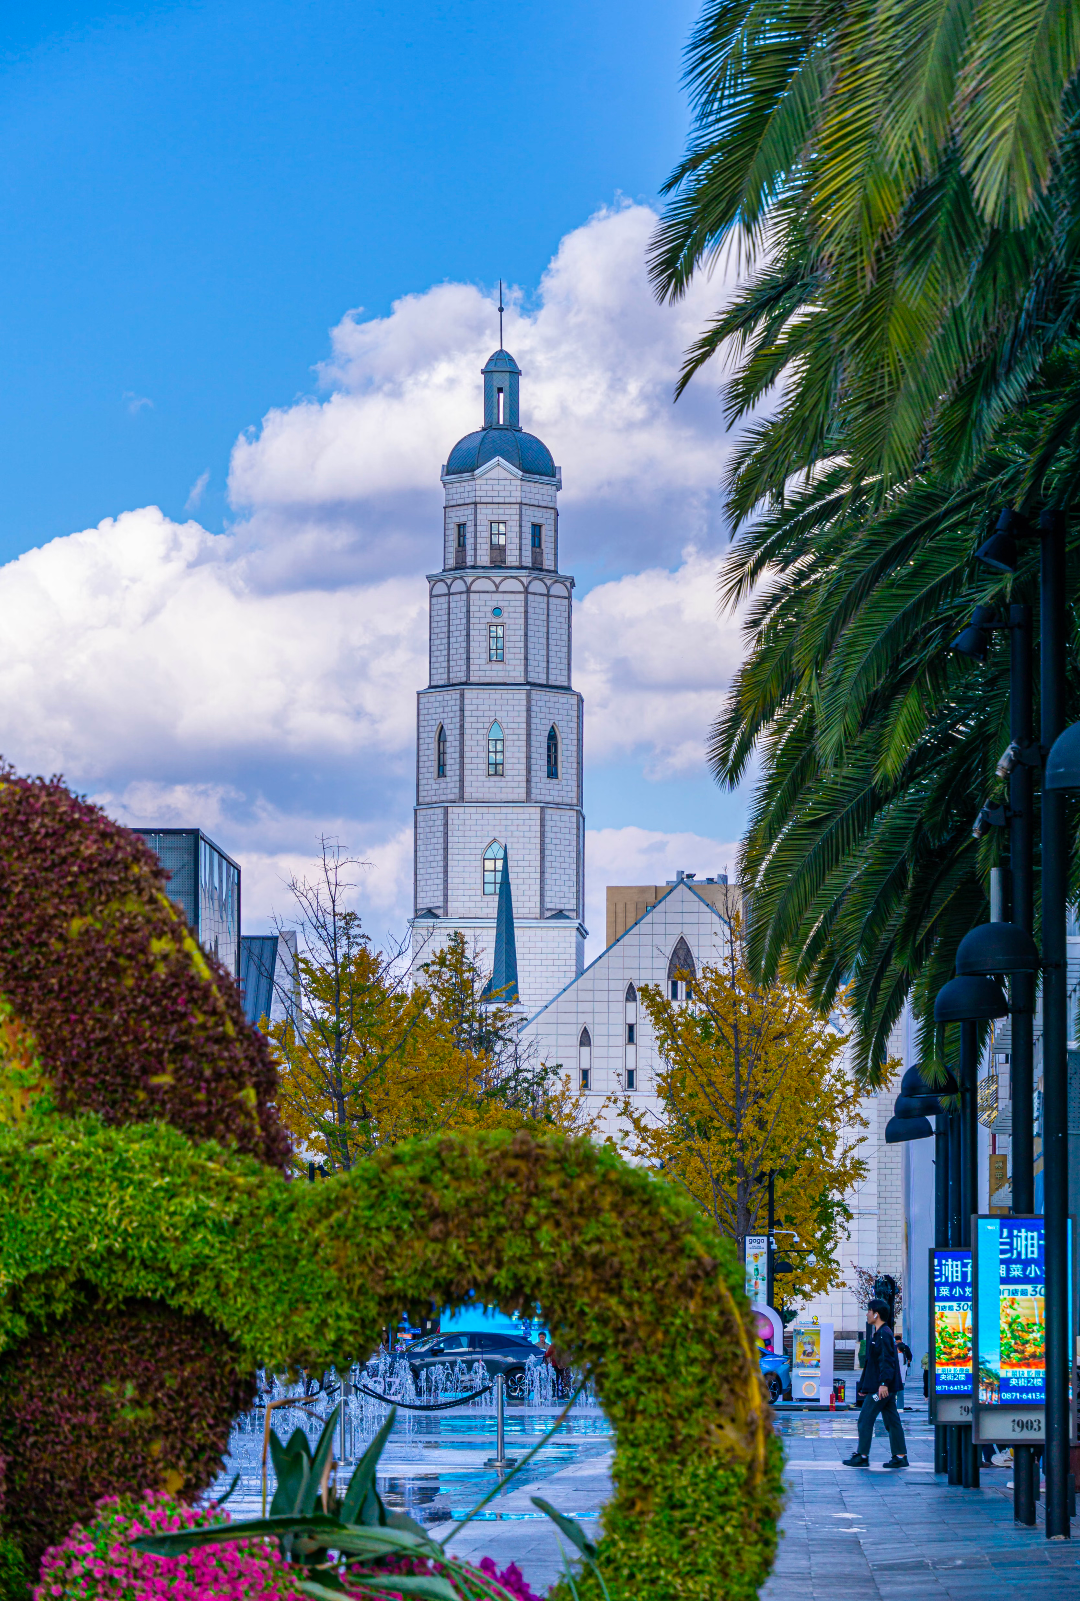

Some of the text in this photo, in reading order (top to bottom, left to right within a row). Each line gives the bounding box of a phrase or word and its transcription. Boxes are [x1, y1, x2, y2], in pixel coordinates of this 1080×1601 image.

[934, 1259, 972, 1283] 湘子
[999, 1264, 1045, 1278] 菜小
[935, 1286, 972, 1297] 菜小炒
[959, 1405, 972, 1417] 19
[1011, 1418, 1042, 1433] 1903
